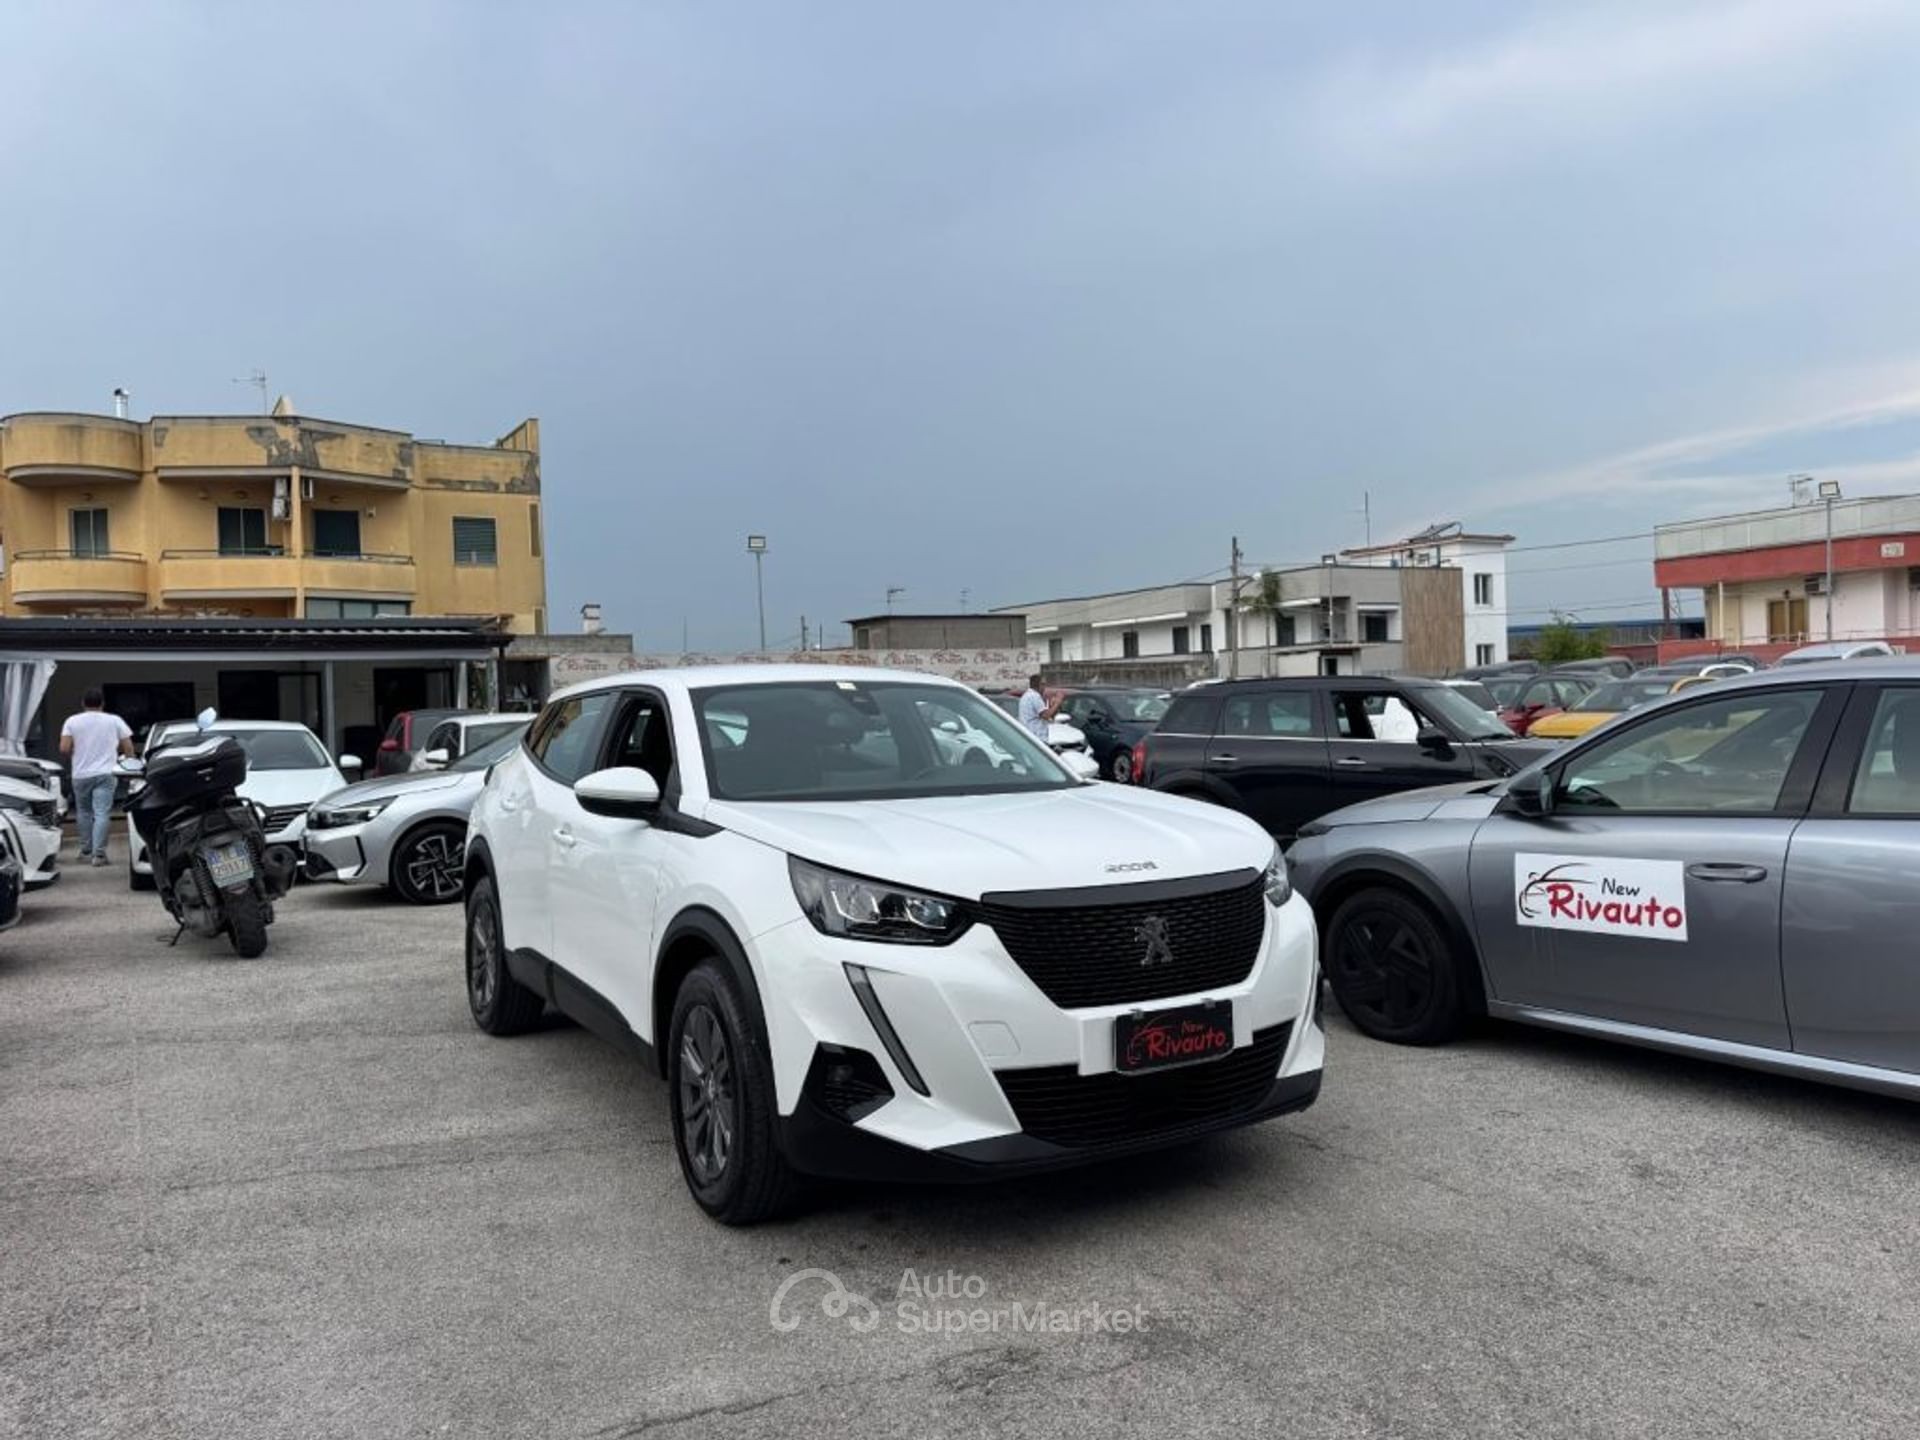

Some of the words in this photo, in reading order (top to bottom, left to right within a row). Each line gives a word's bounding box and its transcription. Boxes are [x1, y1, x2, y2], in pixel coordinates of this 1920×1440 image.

[1601, 877, 1640, 897] New
[1546, 883, 1683, 929] Rivauto
[1182, 1020, 1203, 1033] New
[1147, 1026, 1227, 1058] Rivauto
